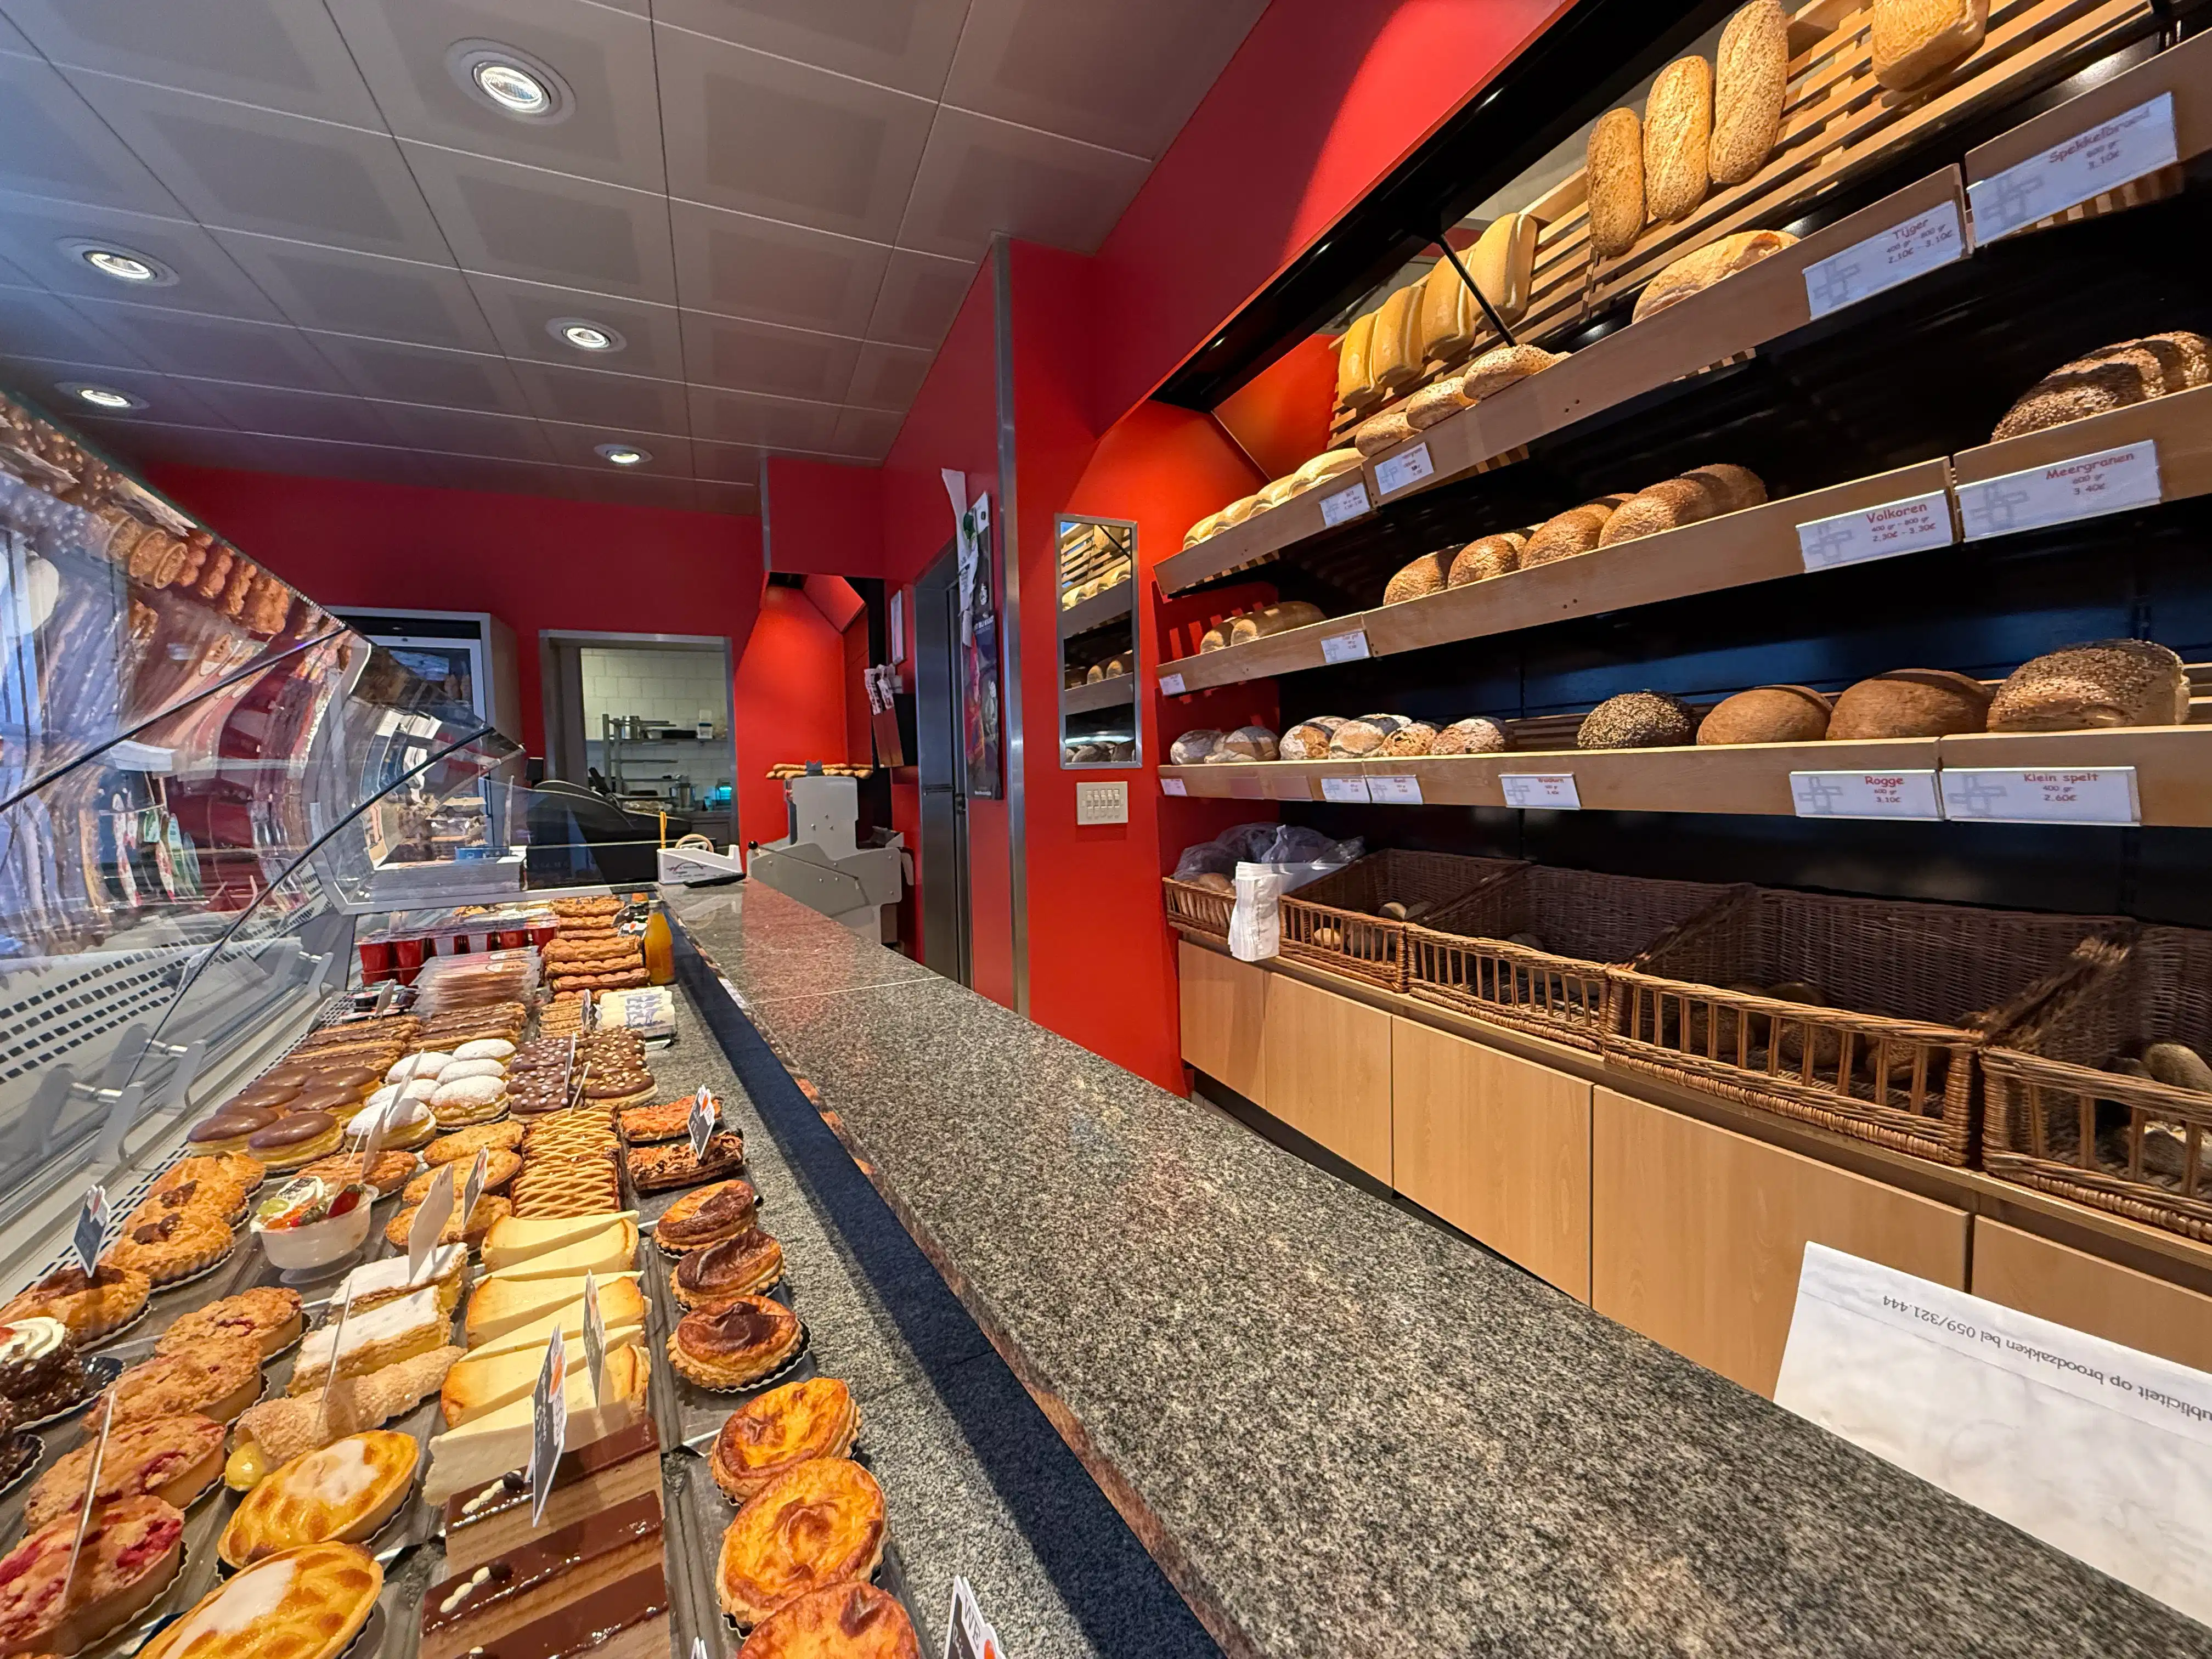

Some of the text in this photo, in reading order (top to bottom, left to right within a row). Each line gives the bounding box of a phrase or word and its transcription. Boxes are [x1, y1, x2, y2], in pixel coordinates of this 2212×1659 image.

[1866, 503, 1928, 523] Volkoren
[1865, 776, 1905, 788] Rogge
[2024, 772, 2099, 784] Klein spelt
[1882, 1295, 1976, 1339] 059/321.444
[1979, 1330, 2002, 1349] bel
[2006, 1338, 2104, 1386] broodzakken
[2109, 1375, 2133, 1391] op
